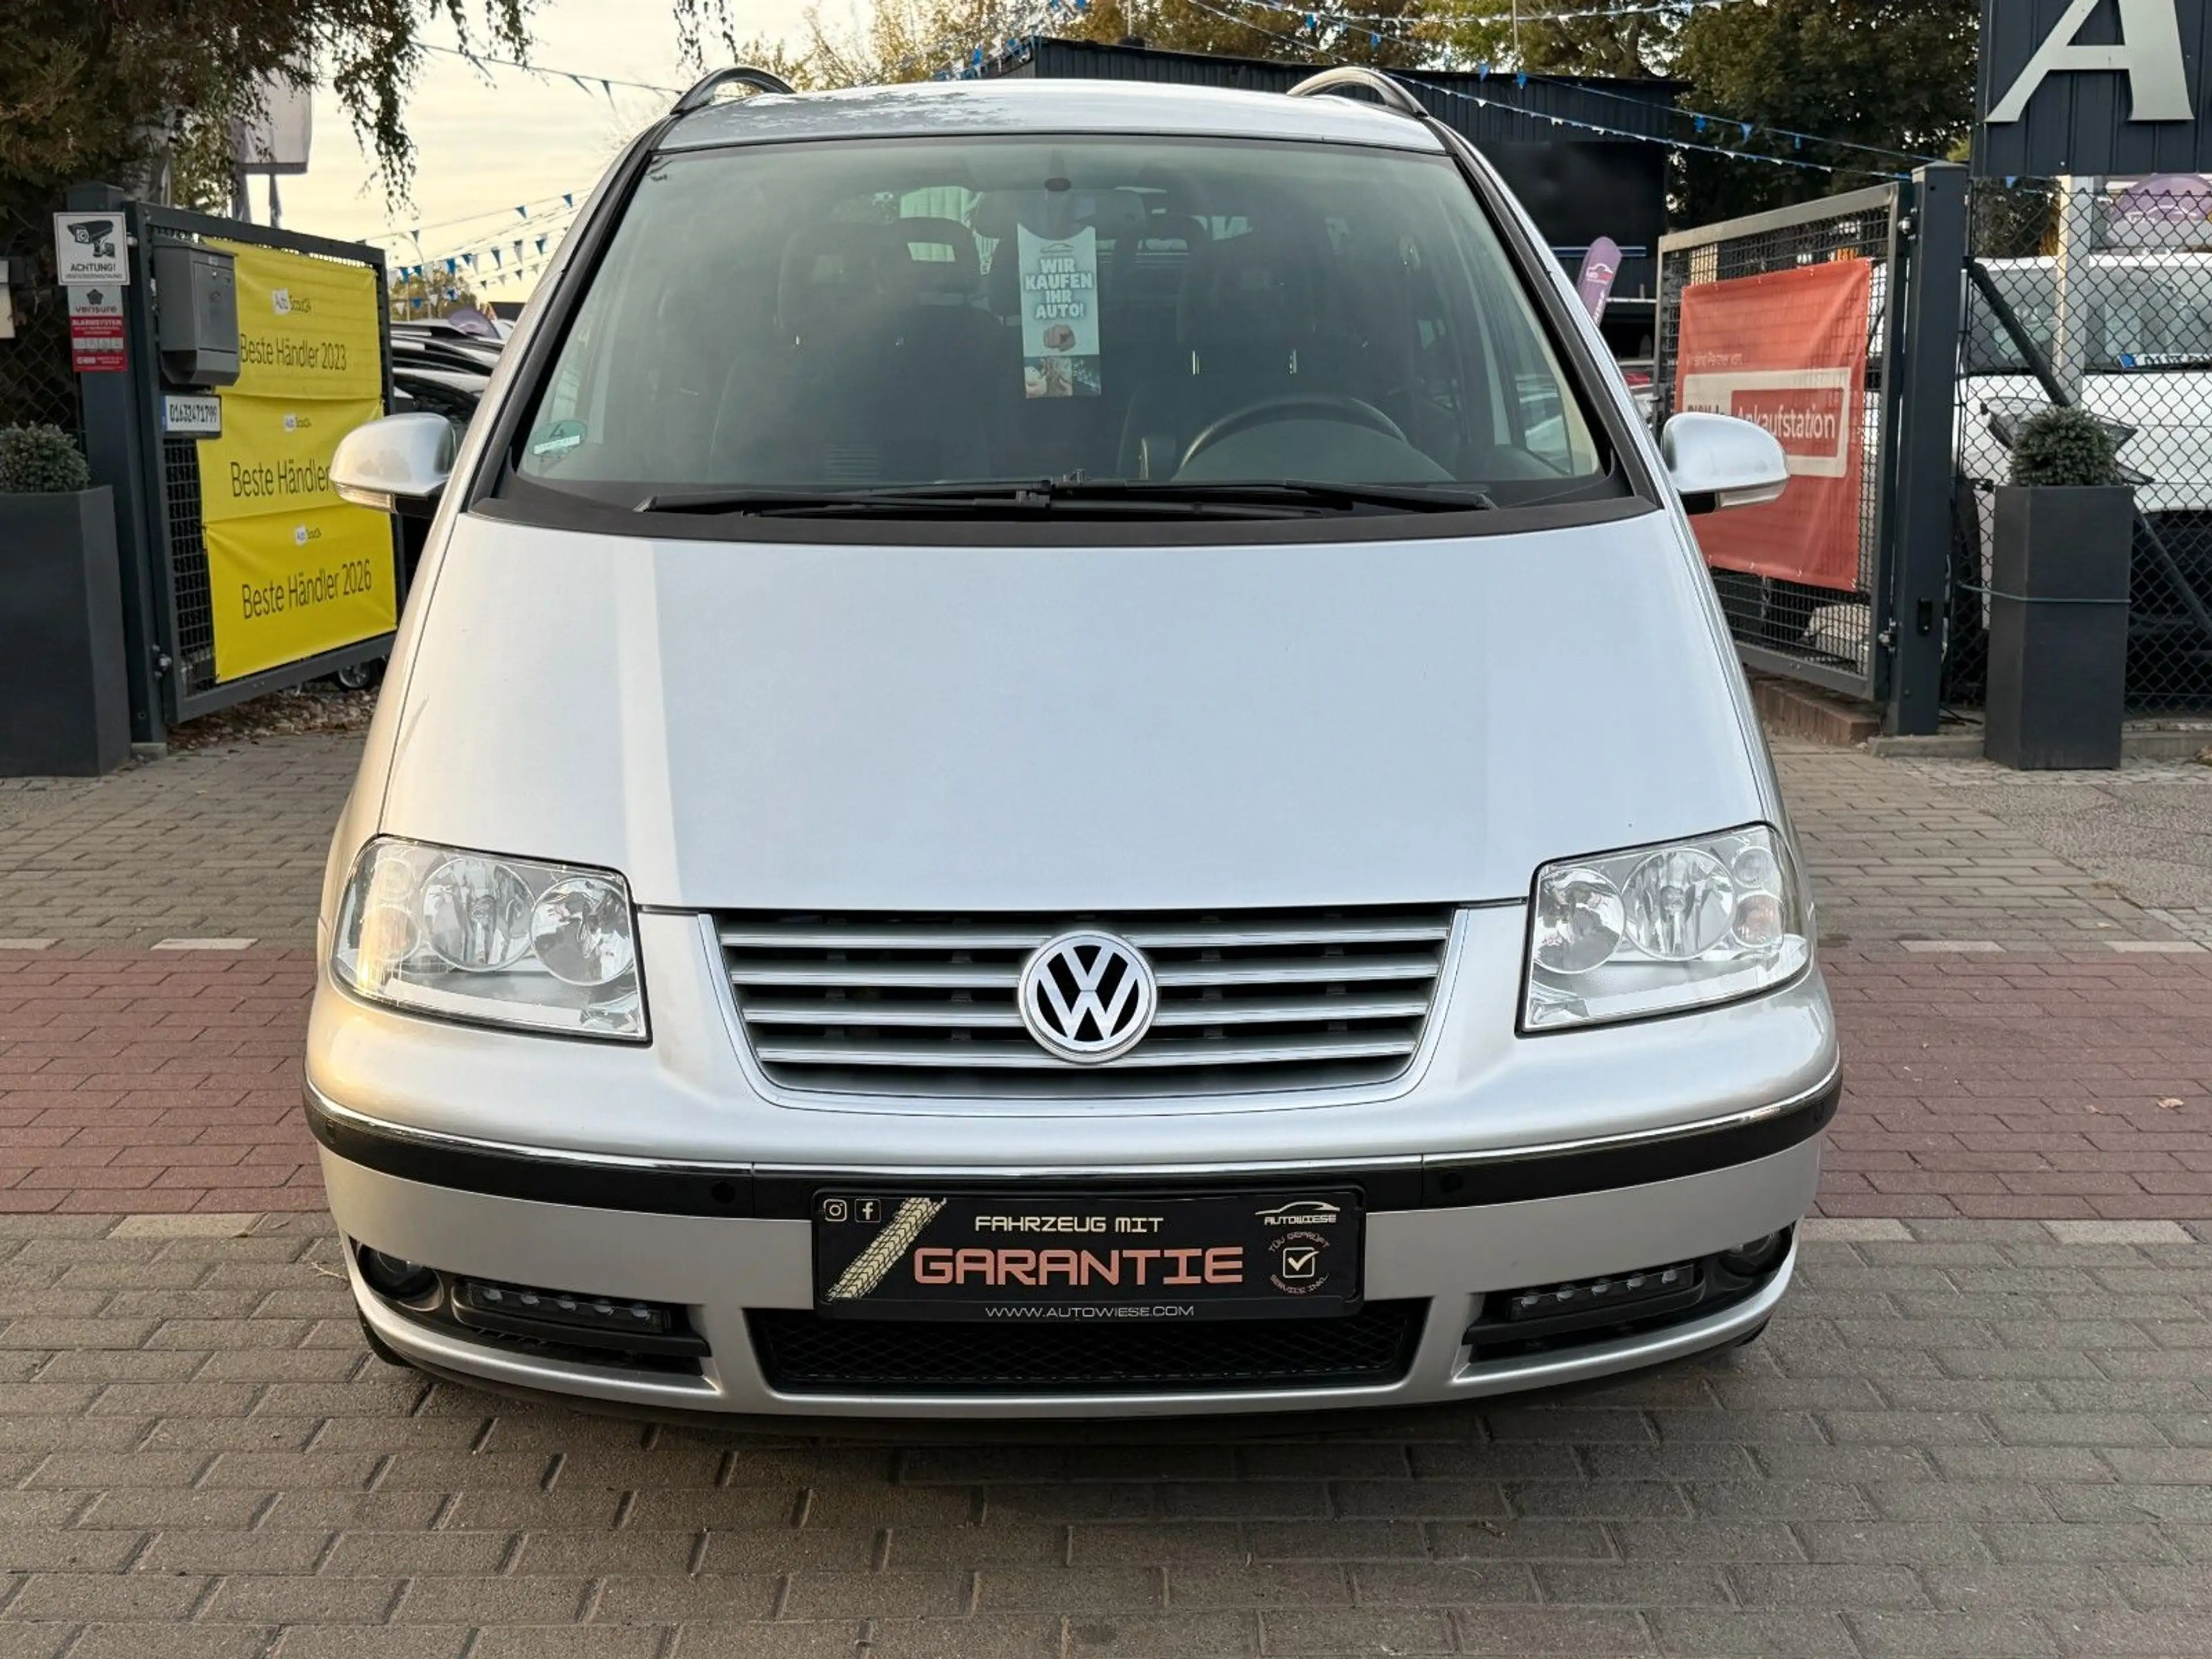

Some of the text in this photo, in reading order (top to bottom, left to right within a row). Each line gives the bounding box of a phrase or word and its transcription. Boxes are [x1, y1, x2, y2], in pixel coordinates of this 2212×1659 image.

[70, 263, 116, 272] ACHTUNG!
[1040, 257, 1075, 273] WIR
[1025, 273, 1093, 290] KAUFEN
[1044, 290, 1072, 304] IHR
[1035, 304, 1084, 319] AUTO!
[240, 332, 347, 371] Beste Händler 2023
[1737, 404, 1836, 438] kaufstation
[231, 459, 330, 498] Beste Händler
[242, 558, 372, 619] Beste Händler 2026
[975, 1216, 1164, 1233] FAHRZEUG MIT
[1264, 1214, 1337, 1225] AUTOWIESE
[914, 1247, 1244, 1286] GARANTIE
[985, 1305, 1194, 1318] WWW.AUTOWIESE.COM
